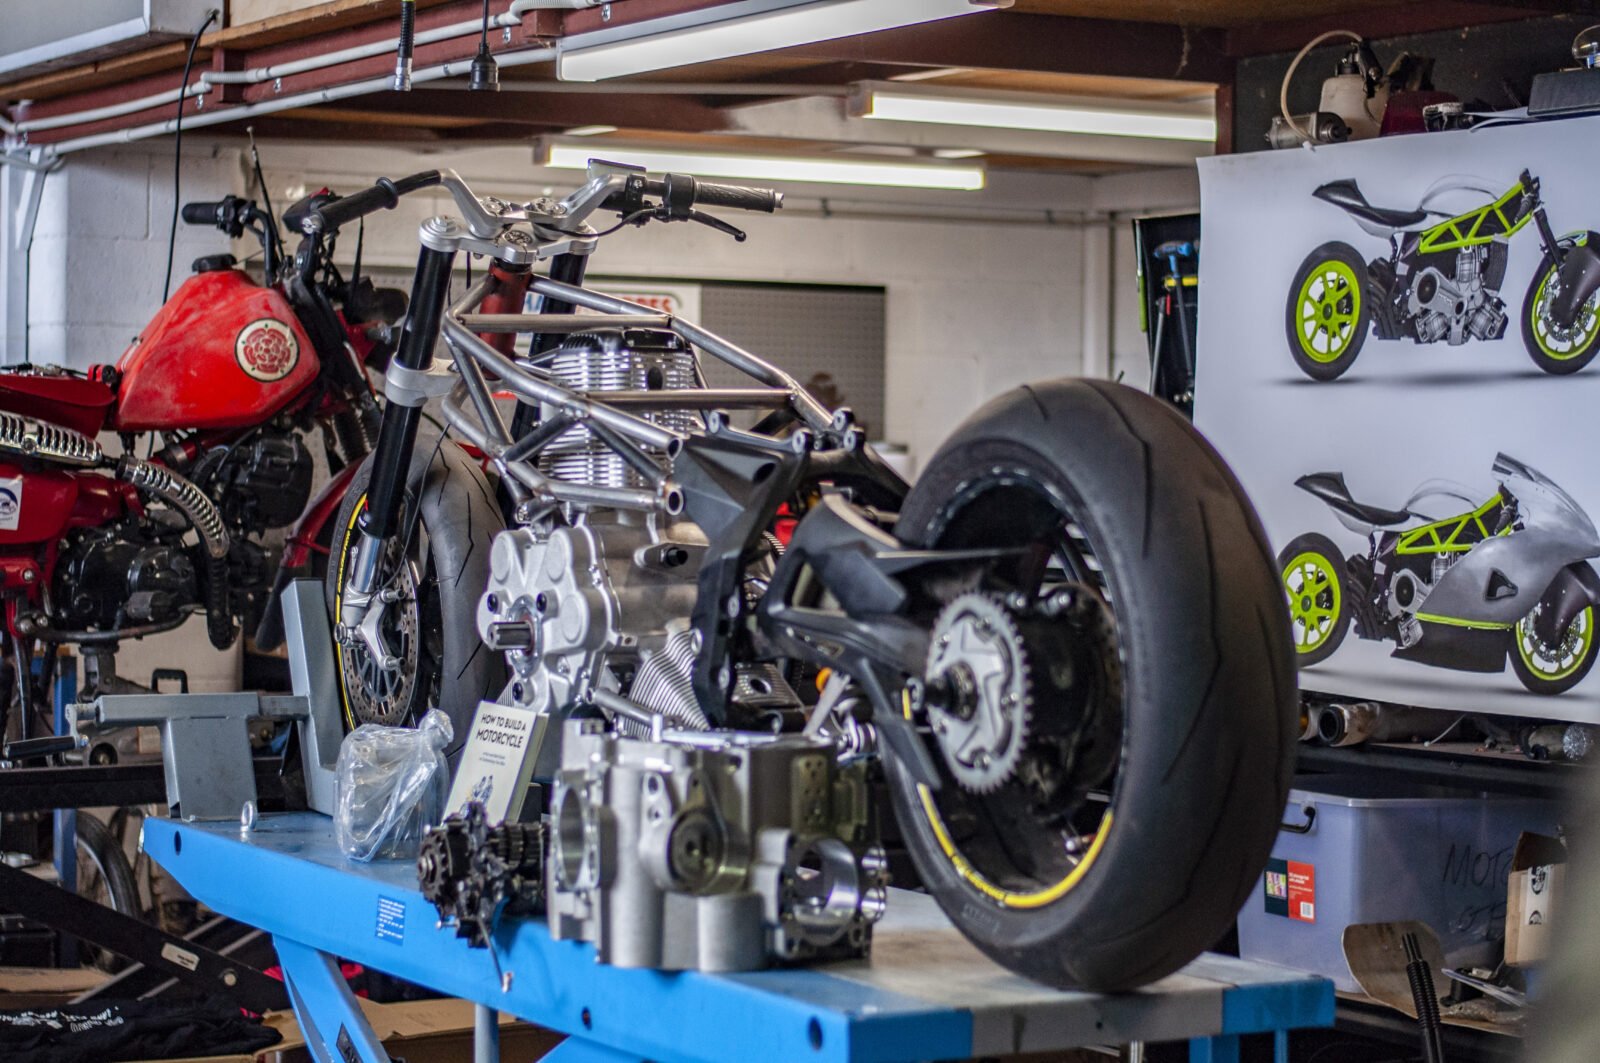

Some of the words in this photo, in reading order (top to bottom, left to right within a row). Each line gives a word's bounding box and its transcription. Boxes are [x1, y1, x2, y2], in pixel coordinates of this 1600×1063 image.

[481, 714, 496, 724] HOW
[496, 716, 504, 727] TO
[505, 718, 522, 730] BUILD
[521, 723, 526, 731] A
[476, 728, 523, 748] MOTORCYCLE
